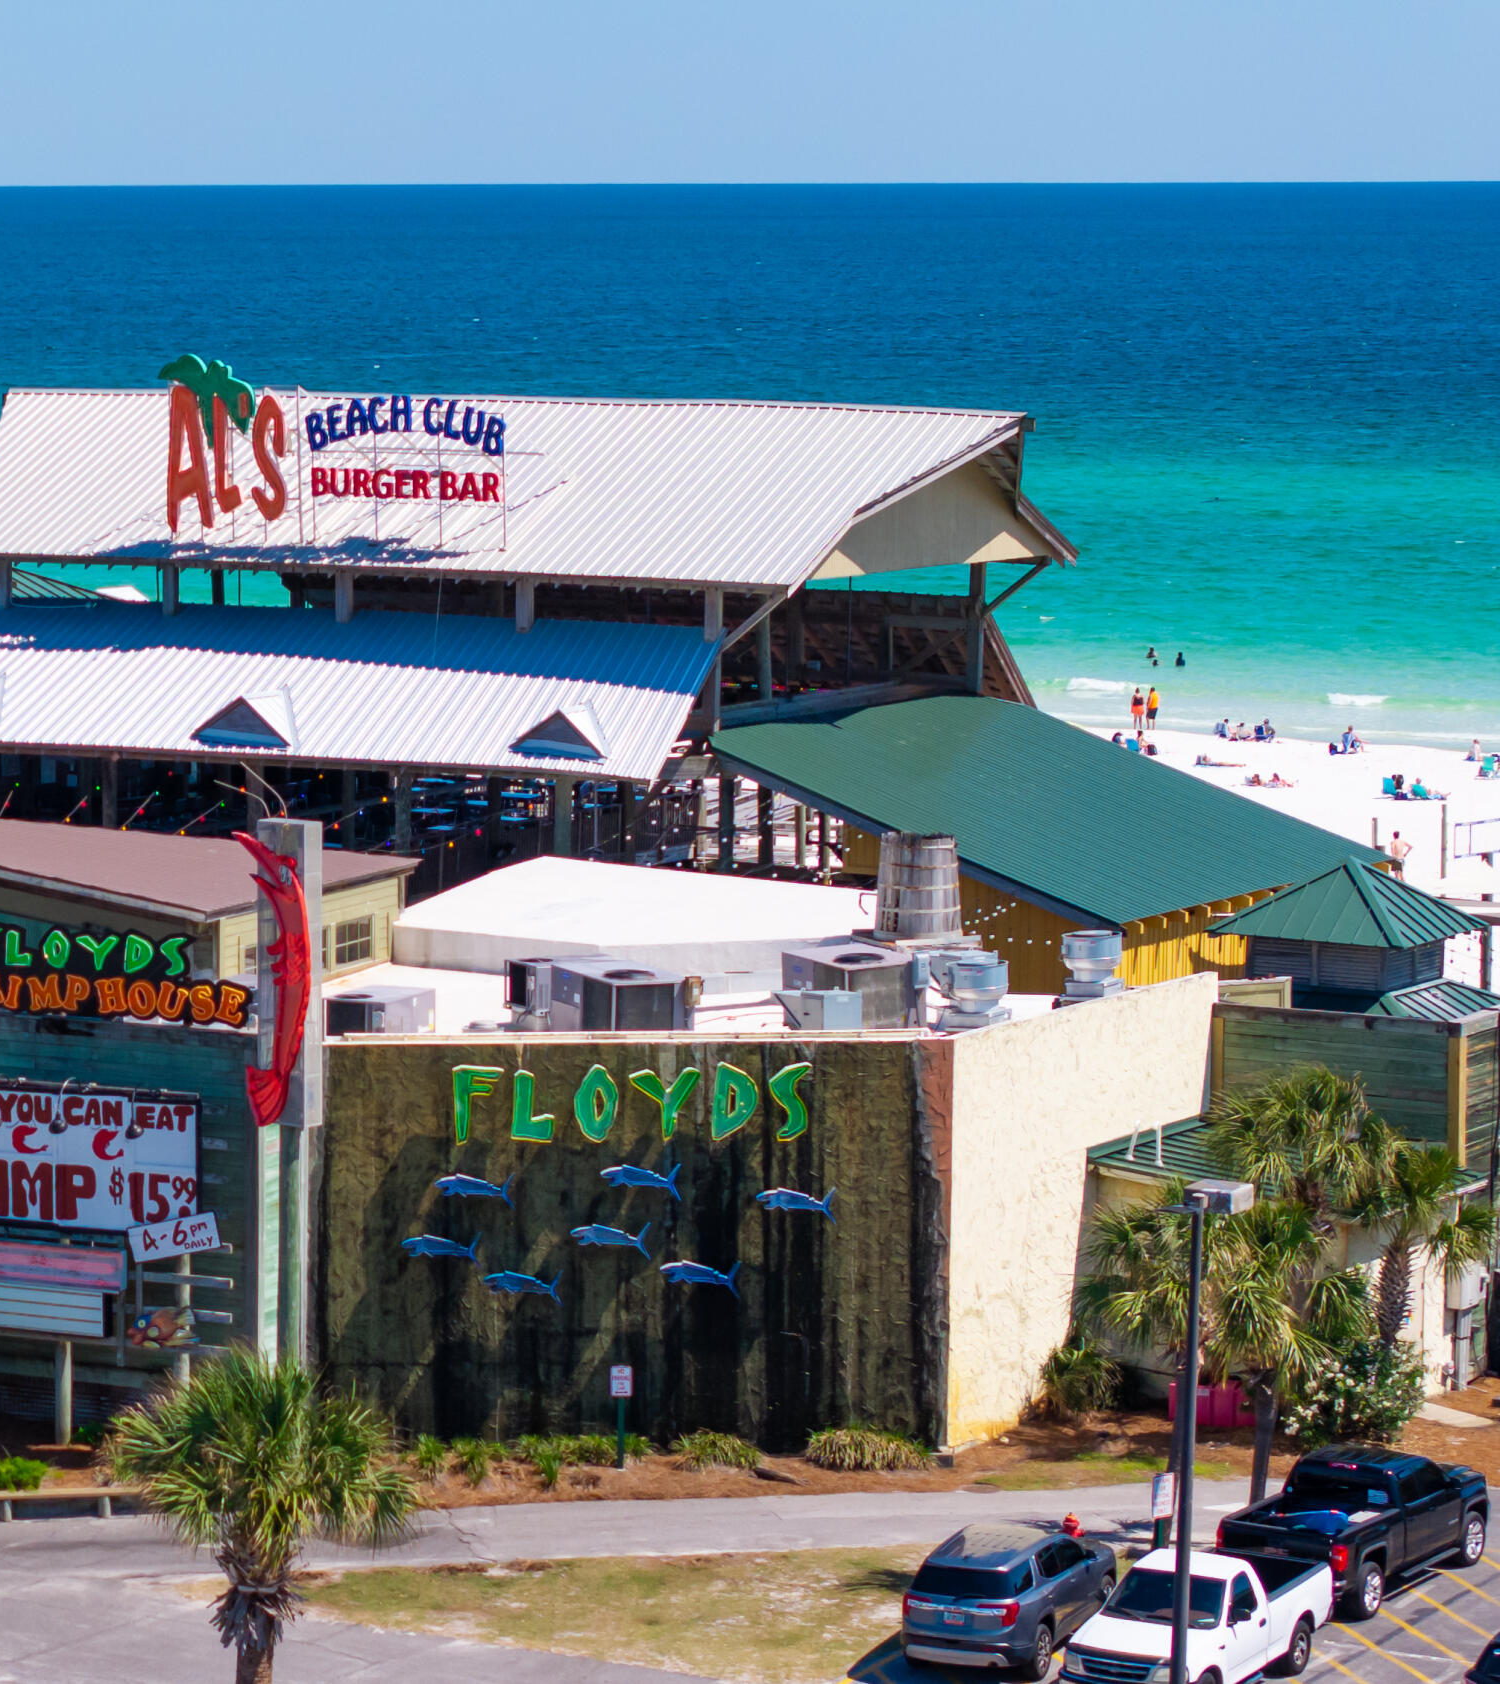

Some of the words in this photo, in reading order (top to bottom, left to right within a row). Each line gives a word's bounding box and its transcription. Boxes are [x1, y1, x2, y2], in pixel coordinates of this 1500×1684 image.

[305, 394, 412, 451] BEACH
[424, 397, 506, 456] CLUB
[311, 467, 431, 500] BURGER
[440, 470, 500, 502] BAR
[96, 977, 248, 1026] HOUSE
[63, 1096, 124, 1127] CAN
[135, 1105, 194, 1132] EAT
[452, 1061, 812, 1145] FLOYDS
[184, 1236, 213, 1250] DAILY
